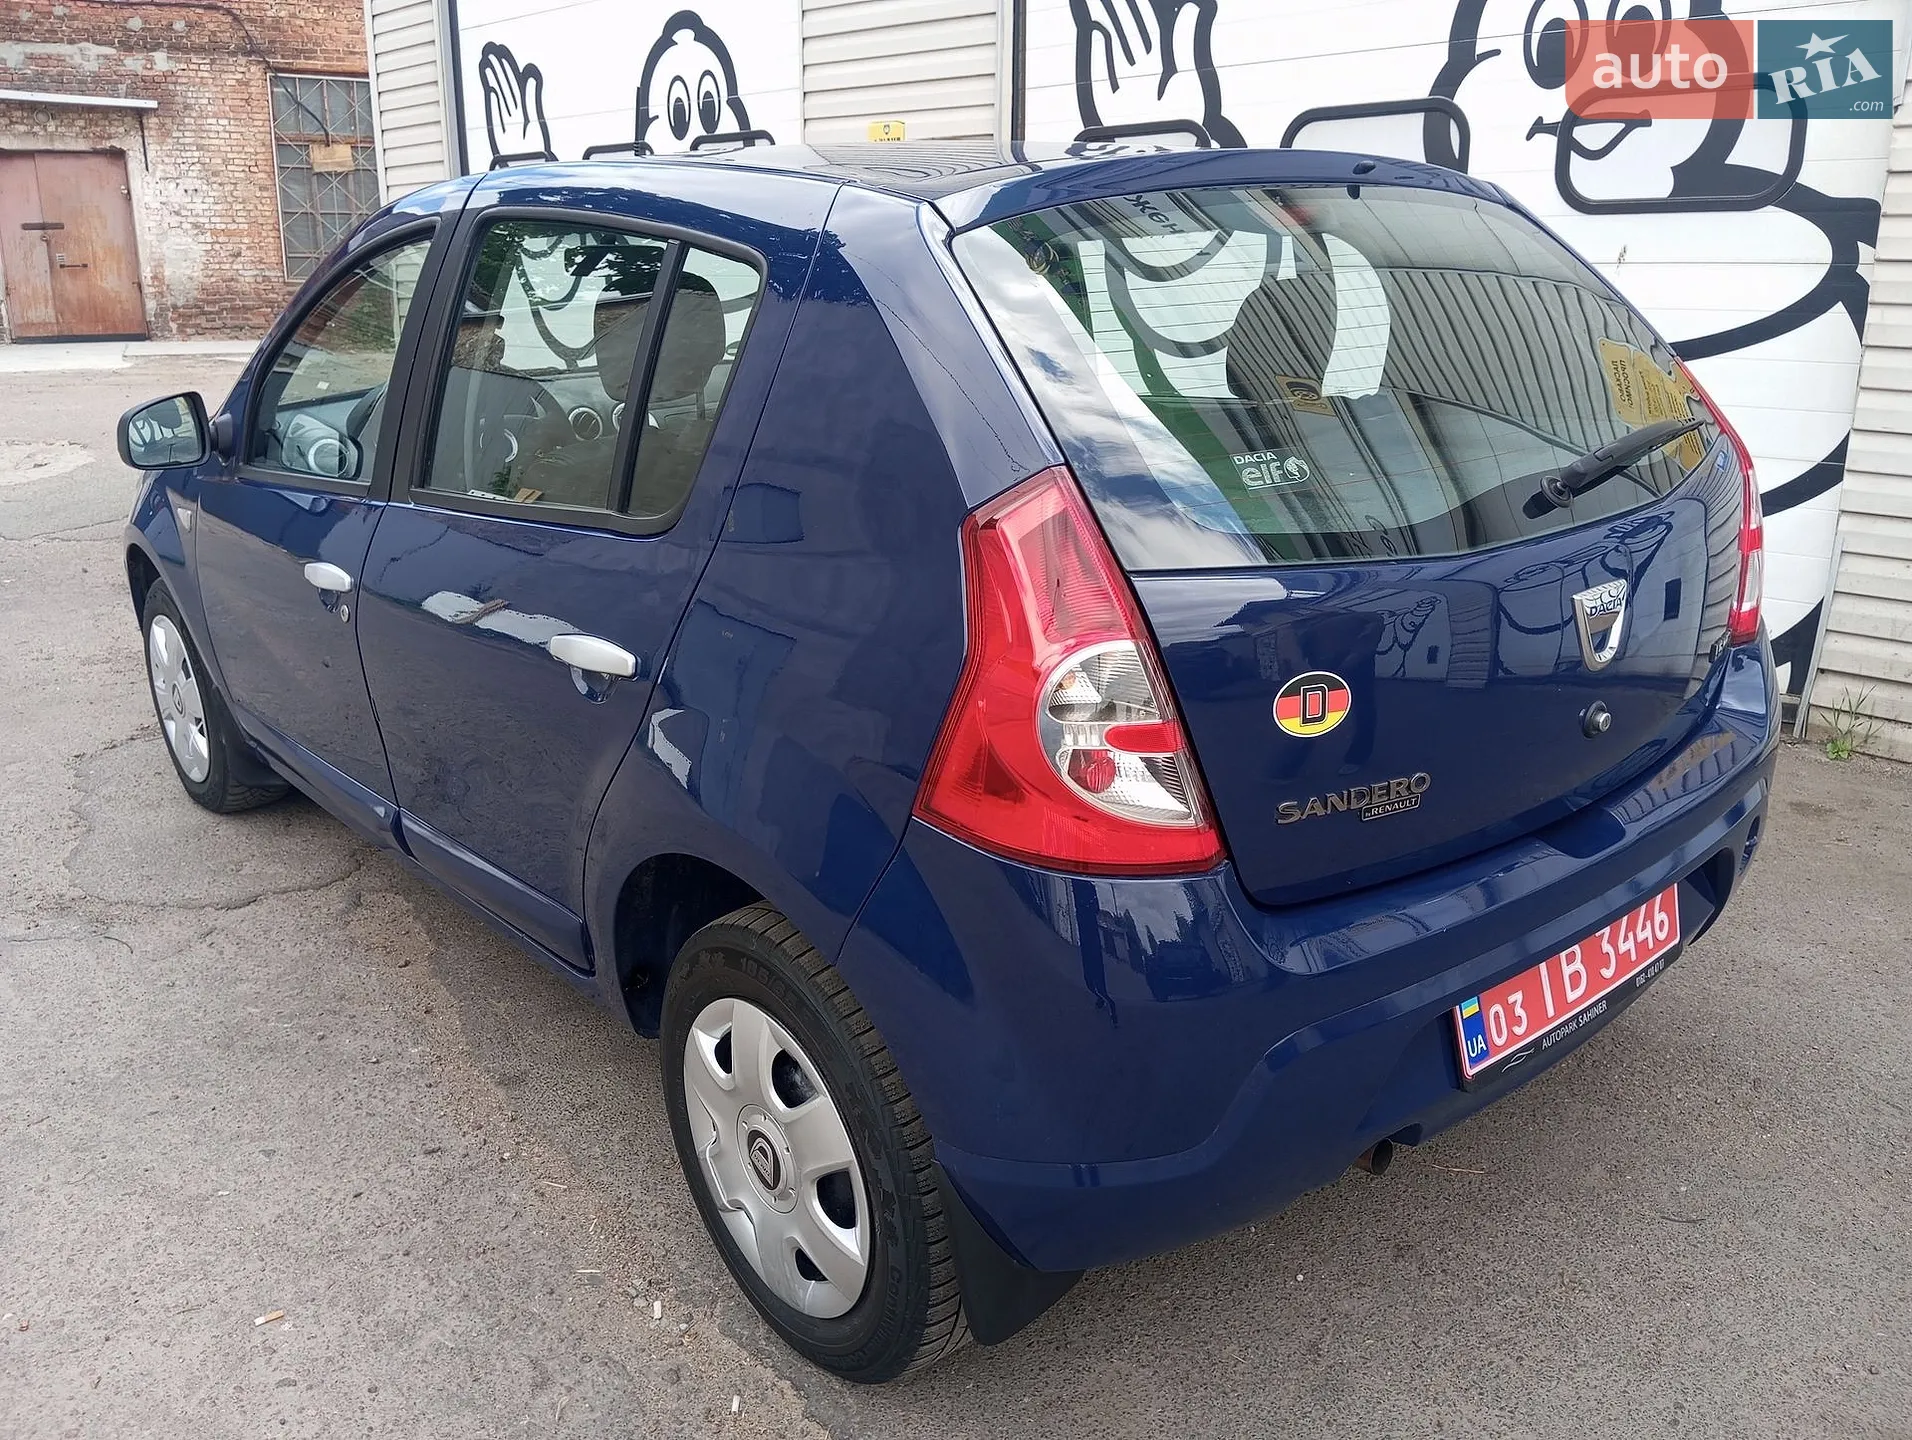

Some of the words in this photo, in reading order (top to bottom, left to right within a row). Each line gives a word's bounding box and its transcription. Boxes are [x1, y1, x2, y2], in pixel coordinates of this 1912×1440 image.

[1233, 452, 1277, 464] DACIA
[1241, 461, 1283, 486] elf
[1589, 599, 1623, 617] DACIA
[1300, 684, 1329, 727] D
[1276, 772, 1431, 824] SANDERO
[1370, 797, 1418, 817] RENAULT
[1489, 989, 1528, 1047] 03
[1594, 892, 1669, 980] 3446
[1541, 1019, 1579, 1050] AUTOPARK
[1578, 999, 1608, 1028] SAHINER
[1466, 1033, 1487, 1057] UA
